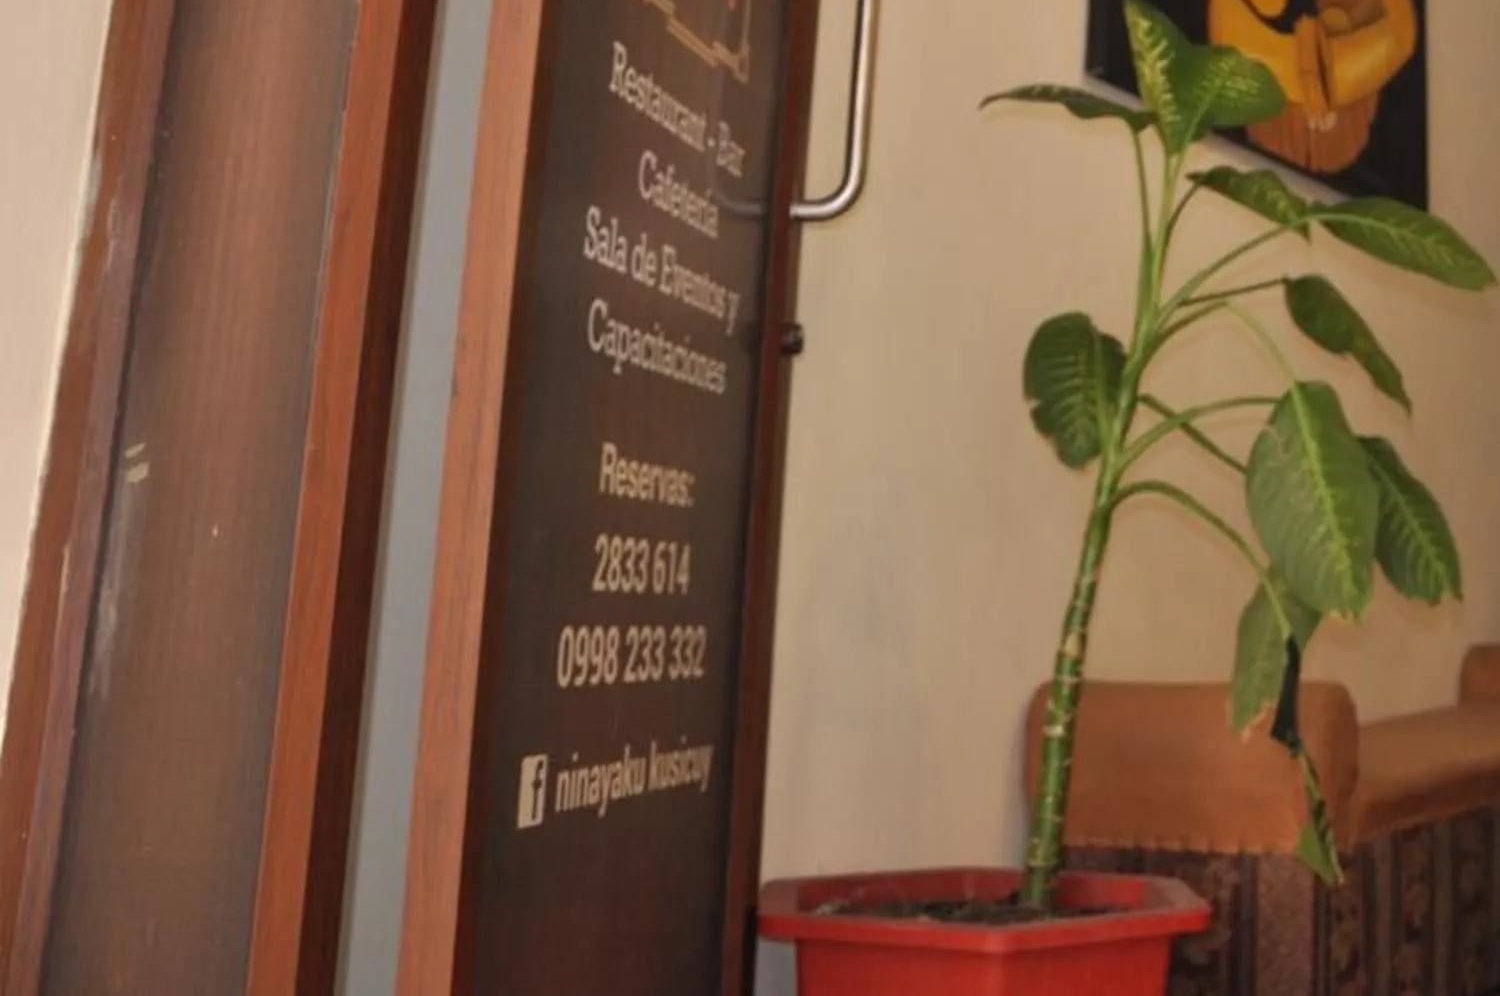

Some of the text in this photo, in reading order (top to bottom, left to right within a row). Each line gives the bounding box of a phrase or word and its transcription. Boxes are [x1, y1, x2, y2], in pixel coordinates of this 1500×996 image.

[609, 40, 707, 153] Restaurant
[717, 120, 746, 178] Bar
[584, 205, 741, 336] Sala de Eventos y
[588, 298, 727, 395] Capacitaciones
[592, 533, 691, 595] 2833 614
[557, 625, 707, 688] 0998 233 332
[555, 743, 647, 818] ninayaku
